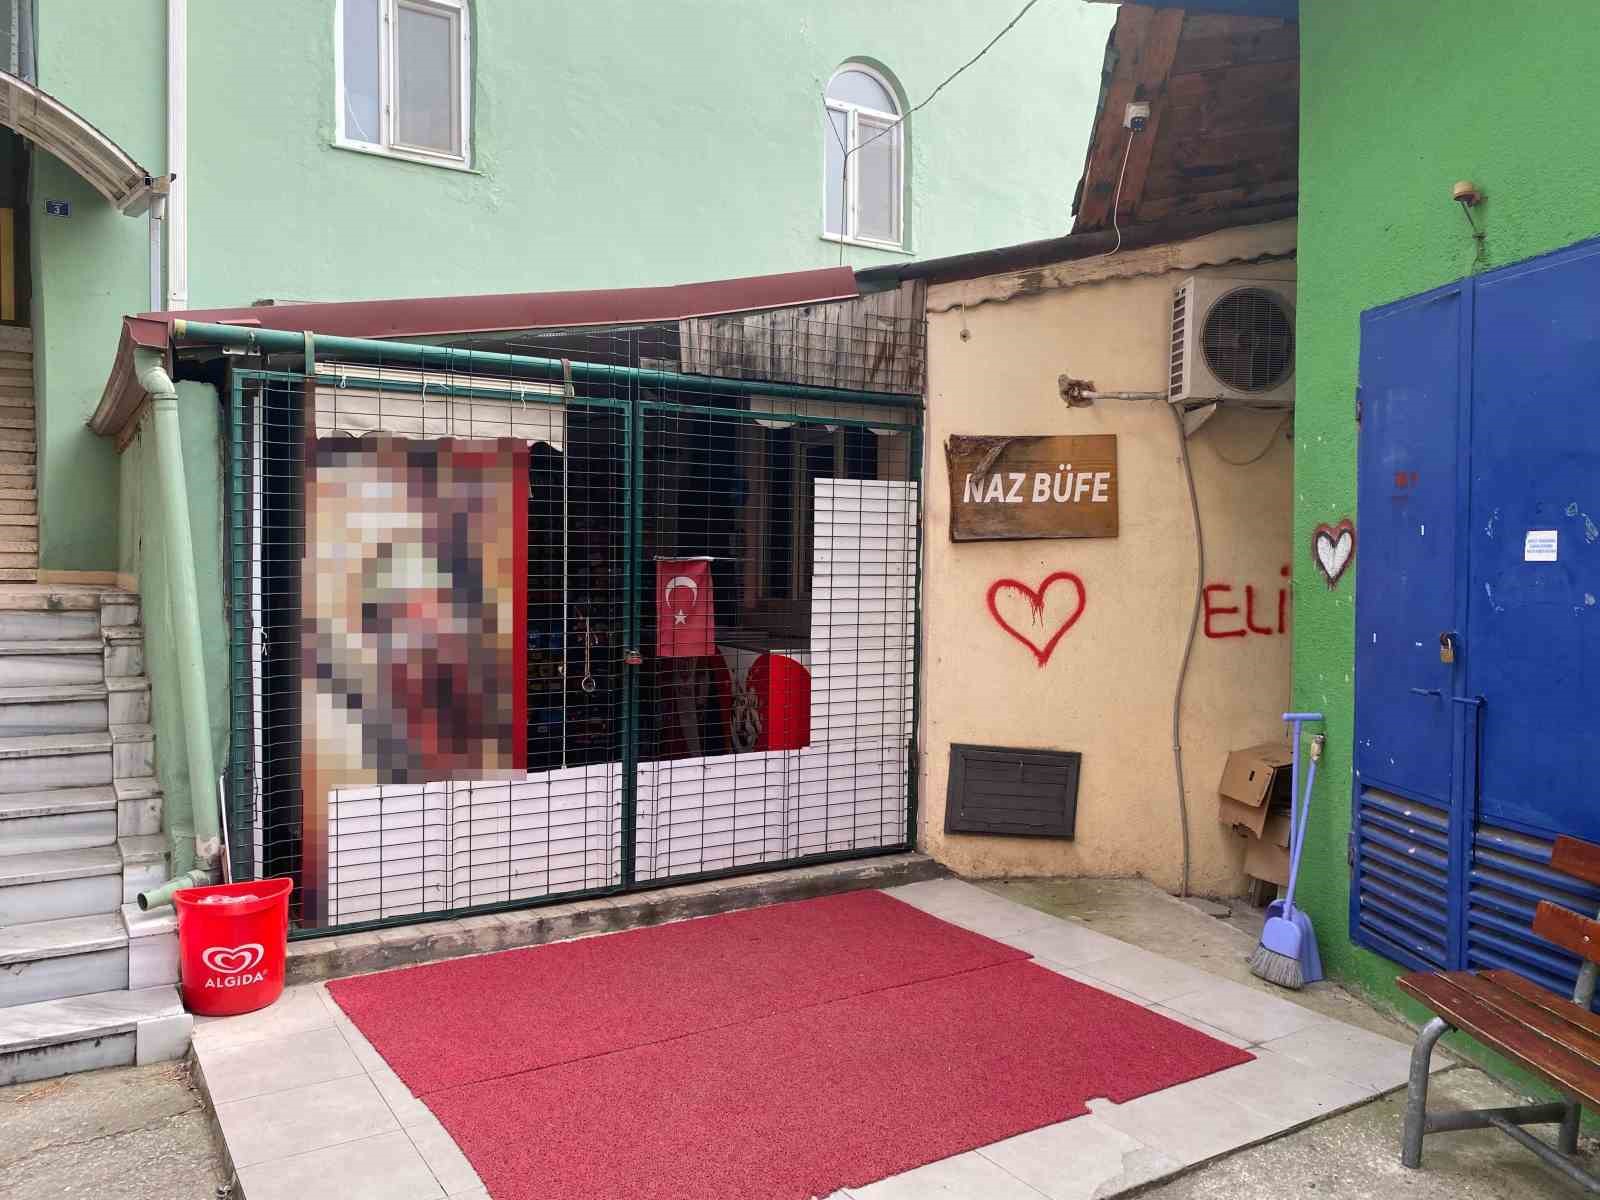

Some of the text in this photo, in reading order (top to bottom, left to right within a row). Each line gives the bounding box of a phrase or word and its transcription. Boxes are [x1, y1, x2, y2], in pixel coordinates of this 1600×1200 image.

[963, 464, 1111, 503] NAZ BÜFE
[204, 972, 264, 988] ALGIDA
